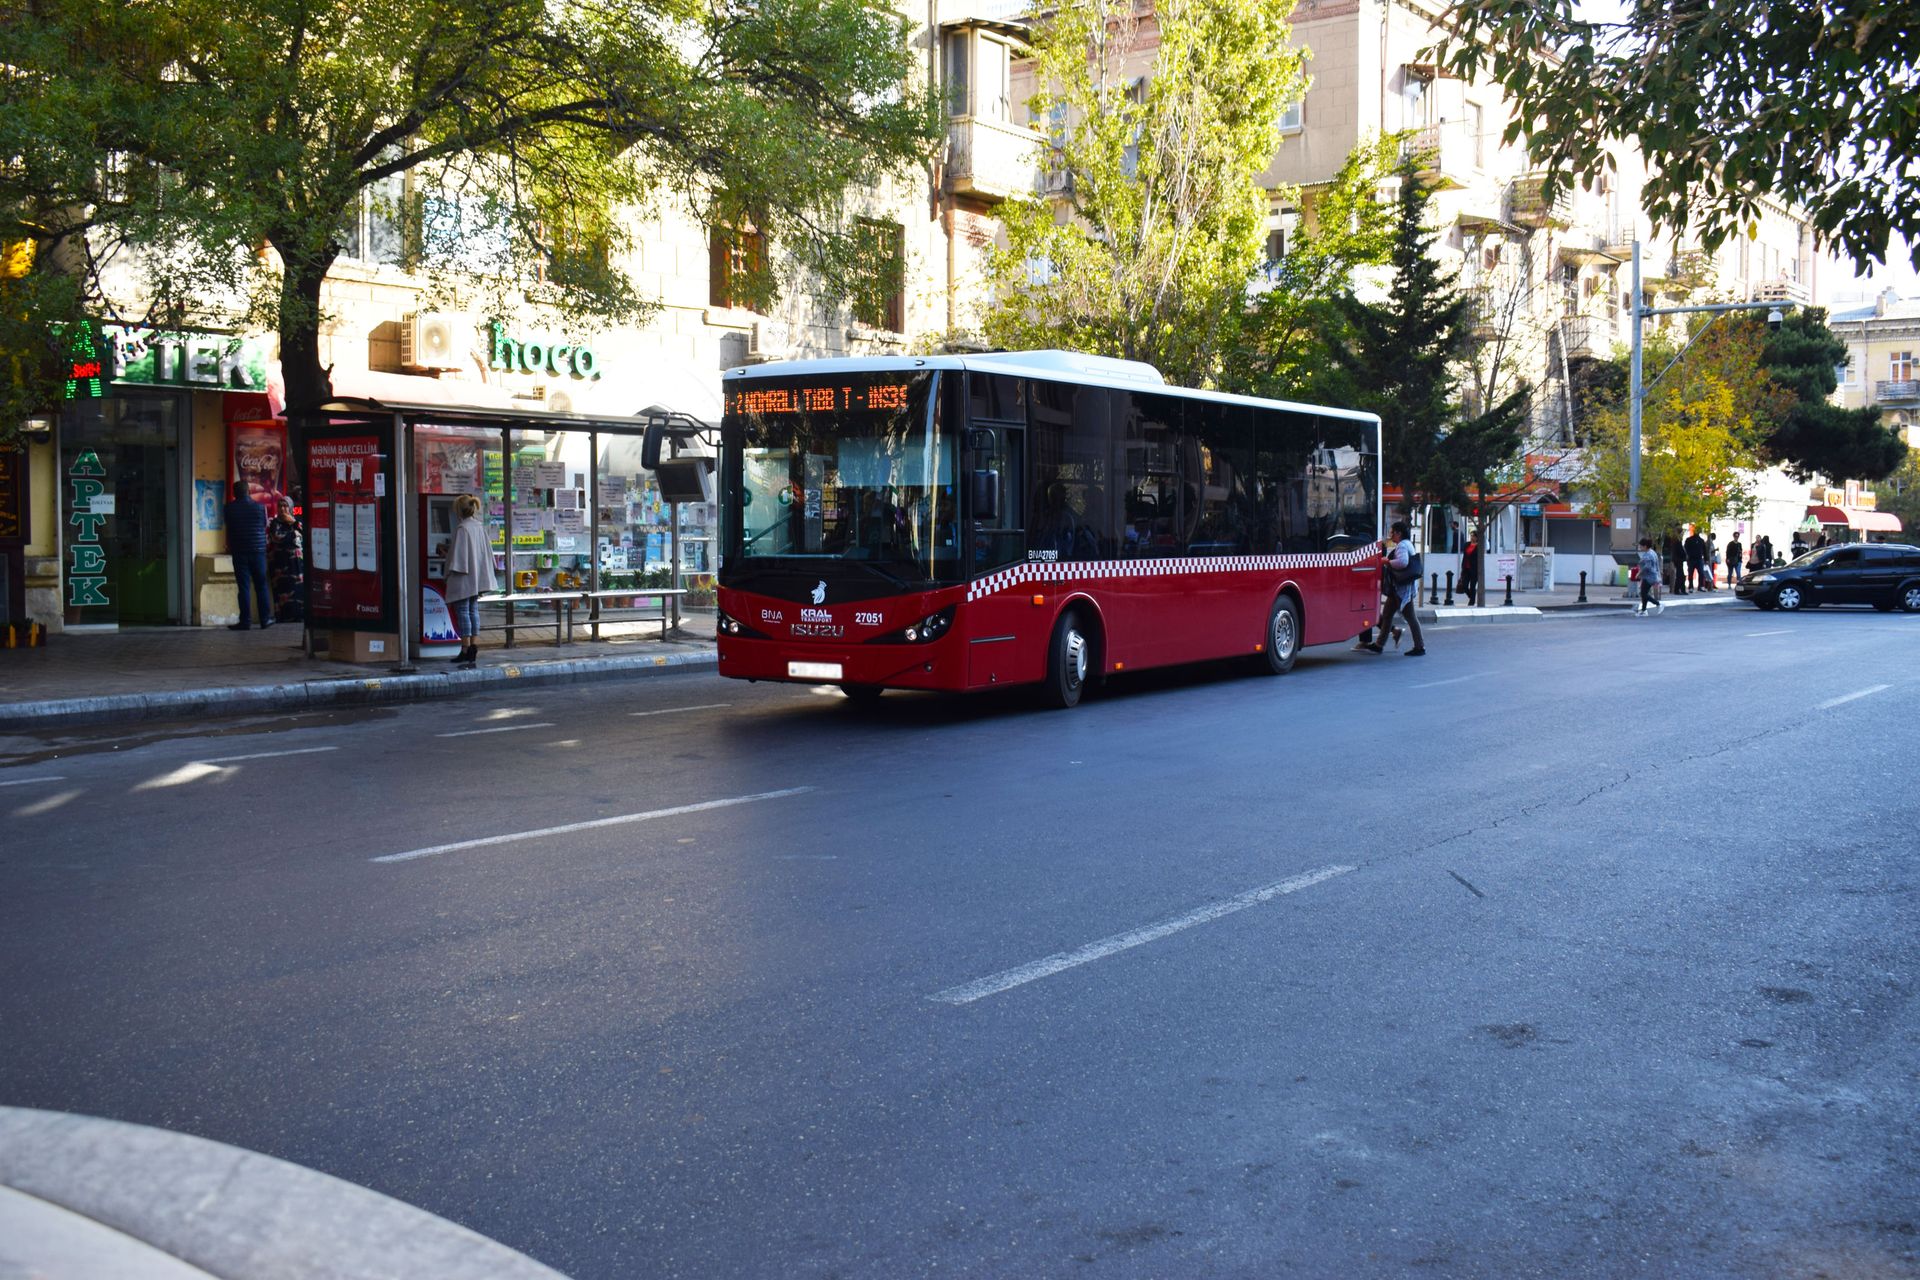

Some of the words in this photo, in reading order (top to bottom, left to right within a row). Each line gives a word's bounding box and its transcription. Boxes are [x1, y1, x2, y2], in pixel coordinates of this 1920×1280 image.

[112, 326, 256, 386] PTEK
[69, 446, 109, 606] APTEK
[761, 609, 783, 621] BNA
[800, 608, 832, 618] KRAL
[855, 612, 883, 623] 27051
[790, 623, 844, 638] ISUZU
